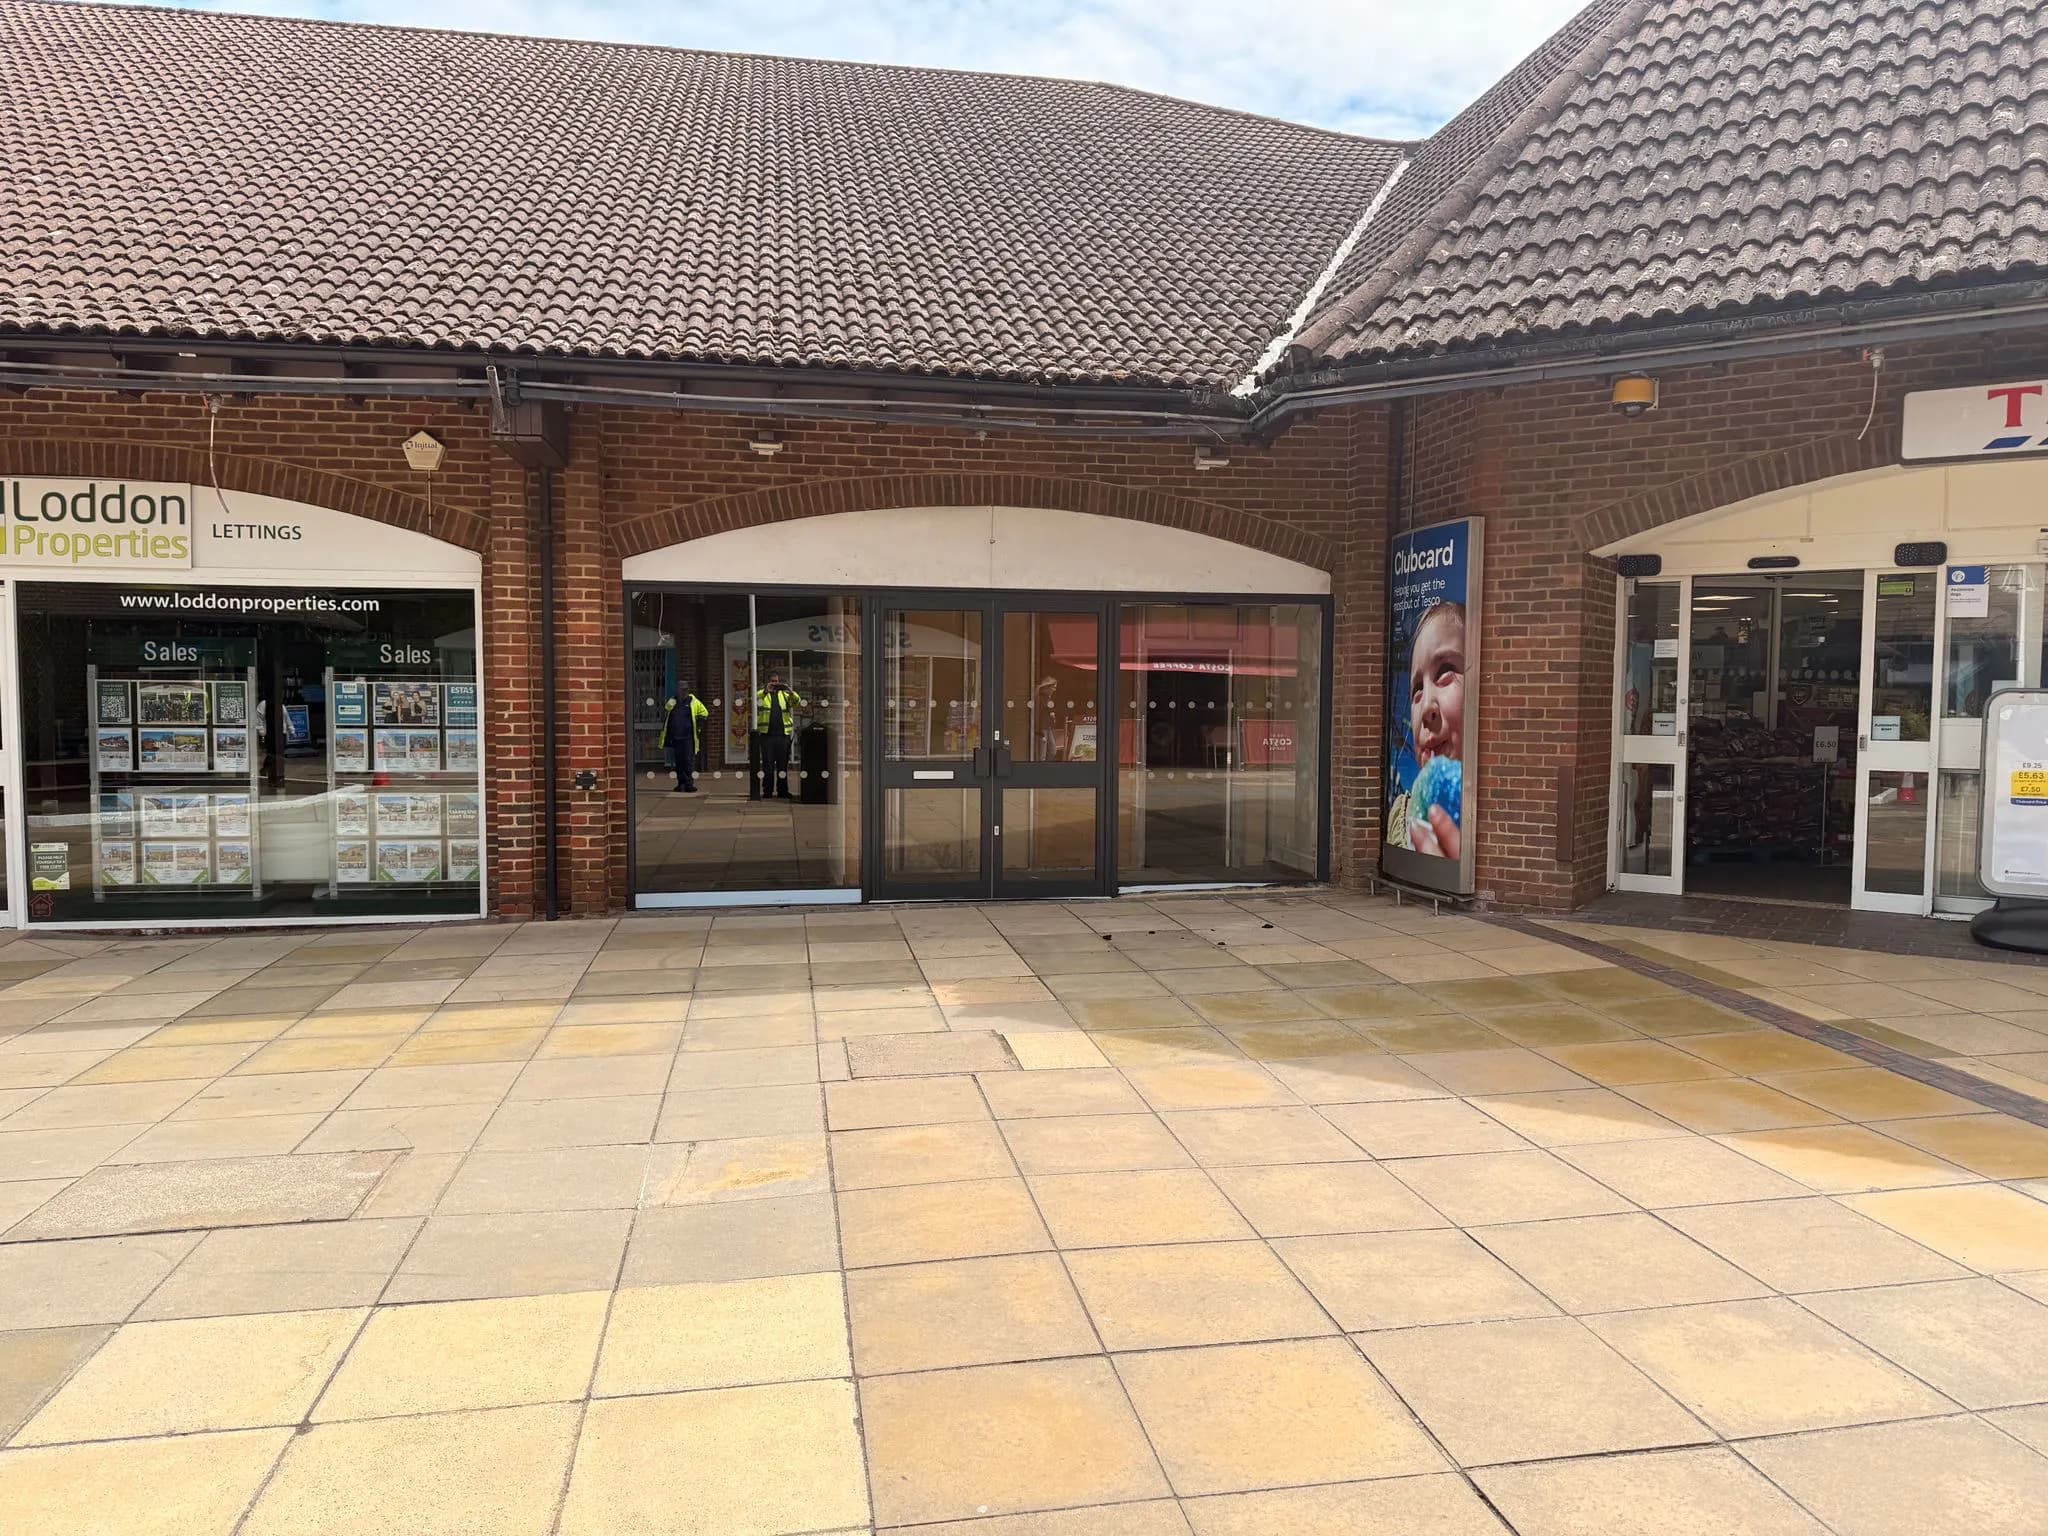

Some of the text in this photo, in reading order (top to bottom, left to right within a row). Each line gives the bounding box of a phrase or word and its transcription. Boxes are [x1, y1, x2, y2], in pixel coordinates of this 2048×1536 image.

[1988, 385, 2048, 428] T
[13, 481, 185, 525] Loddon
[212, 524, 302, 540] LETTINGS
[14, 524, 189, 563] Properties
[1394, 539, 1454, 575] Clubcard
[1410, 583, 1420, 596] you
[1421, 579, 1431, 595] get
[1432, 578, 1446, 590] the
[120, 592, 380, 613] www.loddonproperties.com
[1403, 598, 1413, 610] out
[1413, 596, 1420, 608] of
[1421, 595, 1440, 607] Tesco
[144, 640, 198, 663] Sales
[380, 644, 431, 665] Sales
[451, 686, 474, 694] ESTAS
[1815, 740, 1837, 748] £6.50
